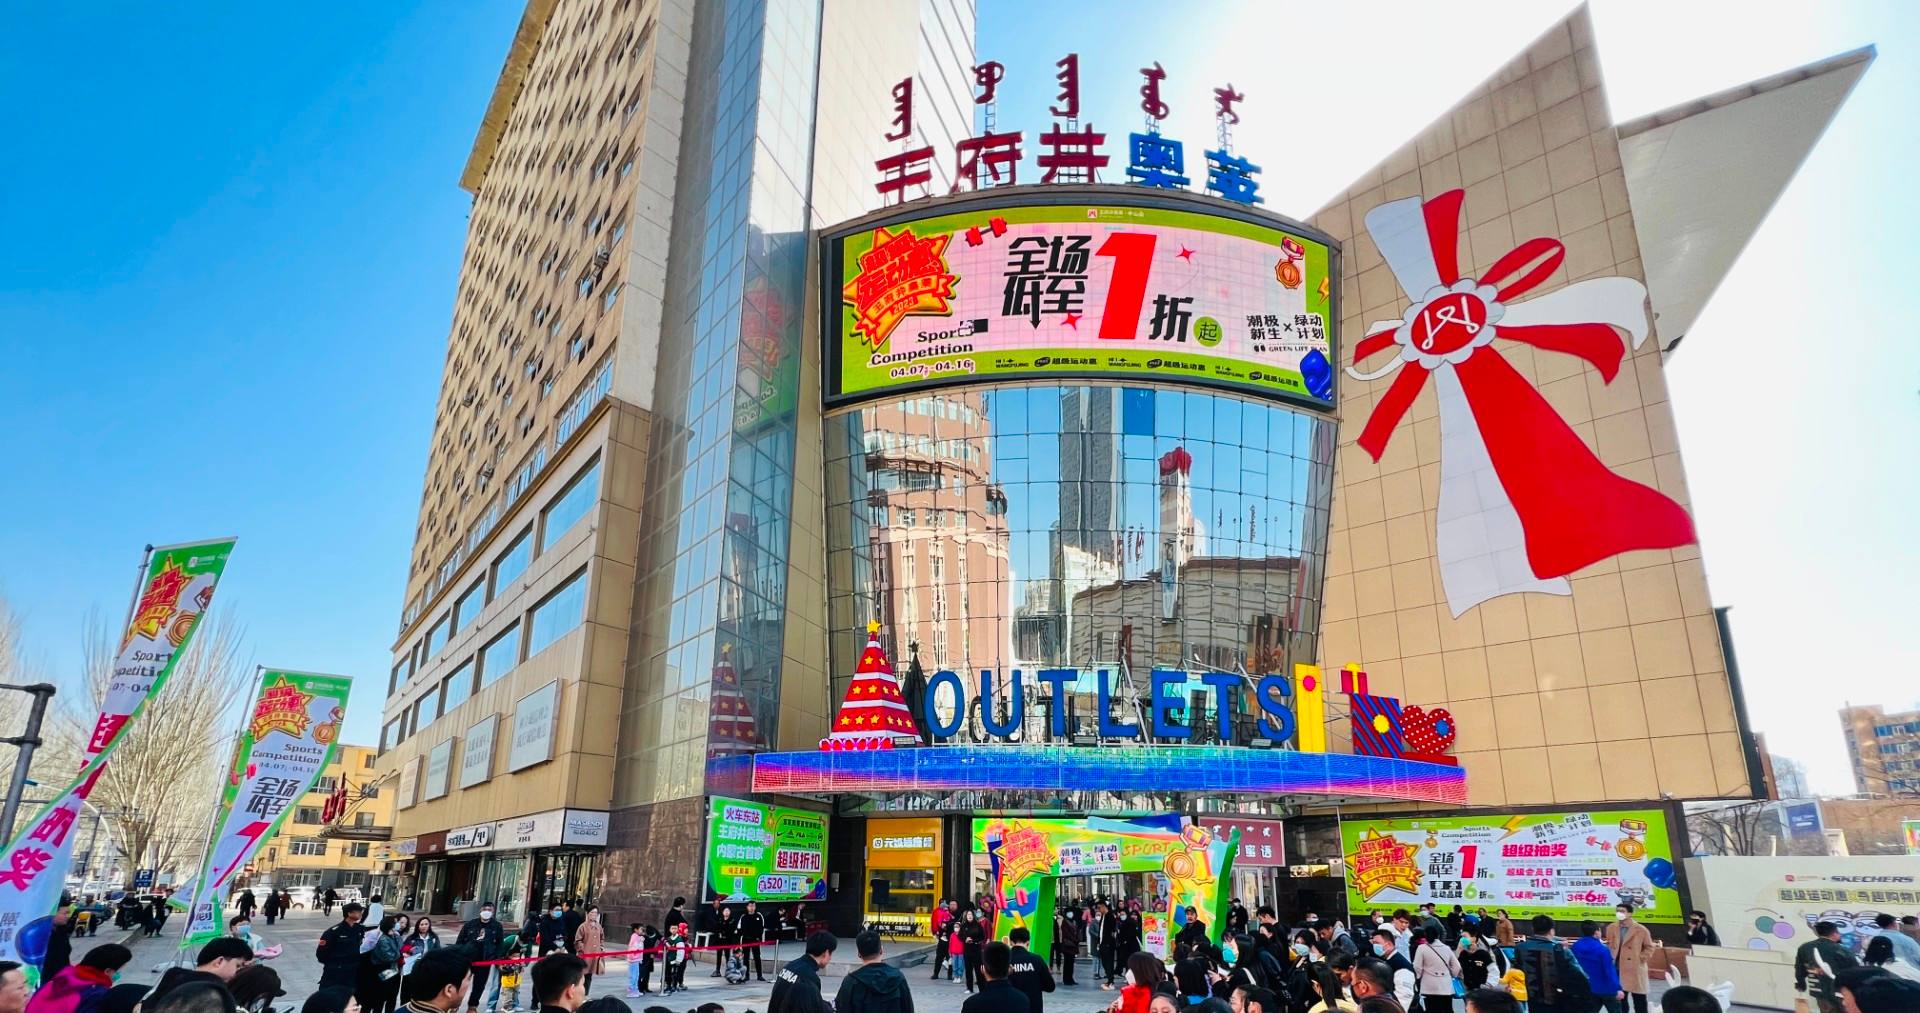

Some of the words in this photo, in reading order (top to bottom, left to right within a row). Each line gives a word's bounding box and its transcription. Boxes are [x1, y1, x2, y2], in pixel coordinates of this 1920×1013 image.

[875, 124, 1265, 206] 王府井奥莱
[1004, 235, 1092, 276] 全场
[1095, 232, 1157, 340] 1
[1002, 274, 1088, 330] 低至
[1246, 314, 1280, 328] 潮极
[1294, 314, 1322, 327] 绿动
[1250, 327, 1282, 341] 新生
[1297, 327, 1324, 340] 计划
[871, 343, 974, 366] Competition
[925, 668, 1296, 745] OUTLETS
[251, 750, 320, 764] Competition
[284, 743, 323, 755] Sports
[251, 776, 301, 798] 全场
[726, 808, 760, 824] 火车东站
[1429, 852, 1455, 864] 全场
[1502, 843, 1568, 857] 超级抽奖
[777, 850, 821, 871] 超级折扣
[1428, 863, 1453, 878] 低至
[1009, 962, 1035, 973] HINA
